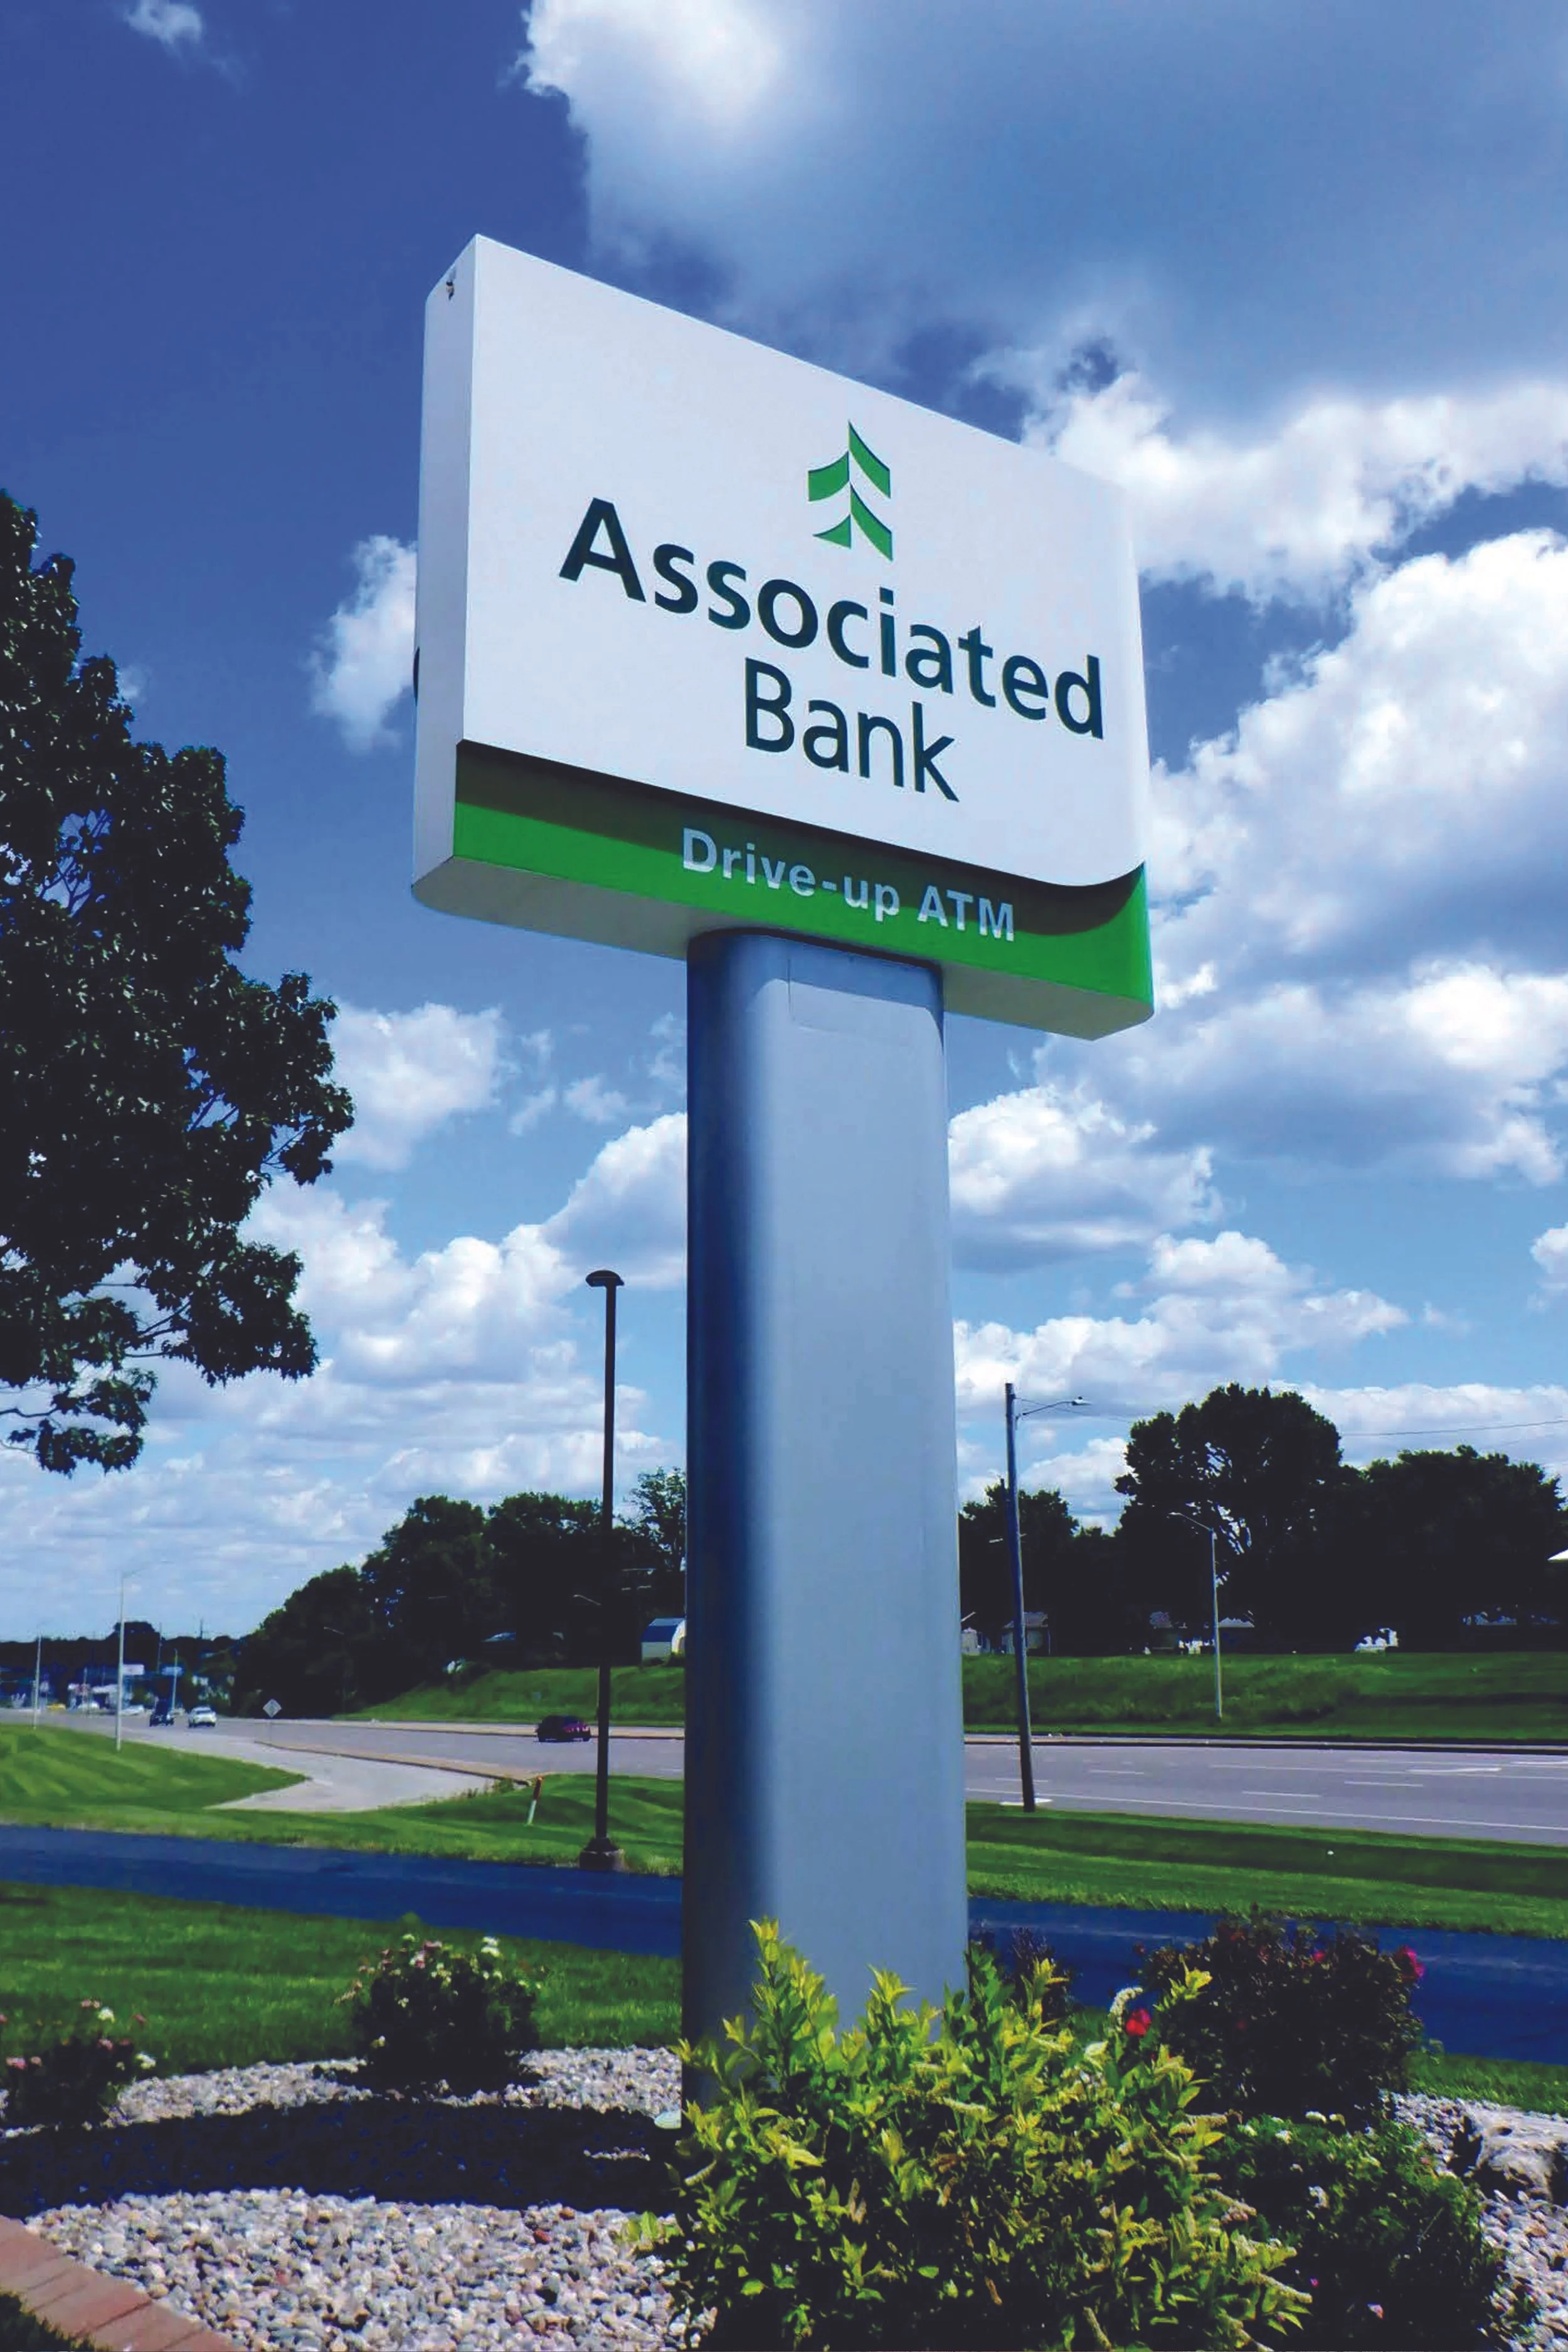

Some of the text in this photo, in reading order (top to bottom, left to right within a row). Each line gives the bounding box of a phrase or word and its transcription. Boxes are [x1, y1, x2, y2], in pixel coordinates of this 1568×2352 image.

[559, 497, 1104, 740] Associated
[745, 657, 960, 802] Bank
[682, 827, 1015, 941] Drive-up ATM
